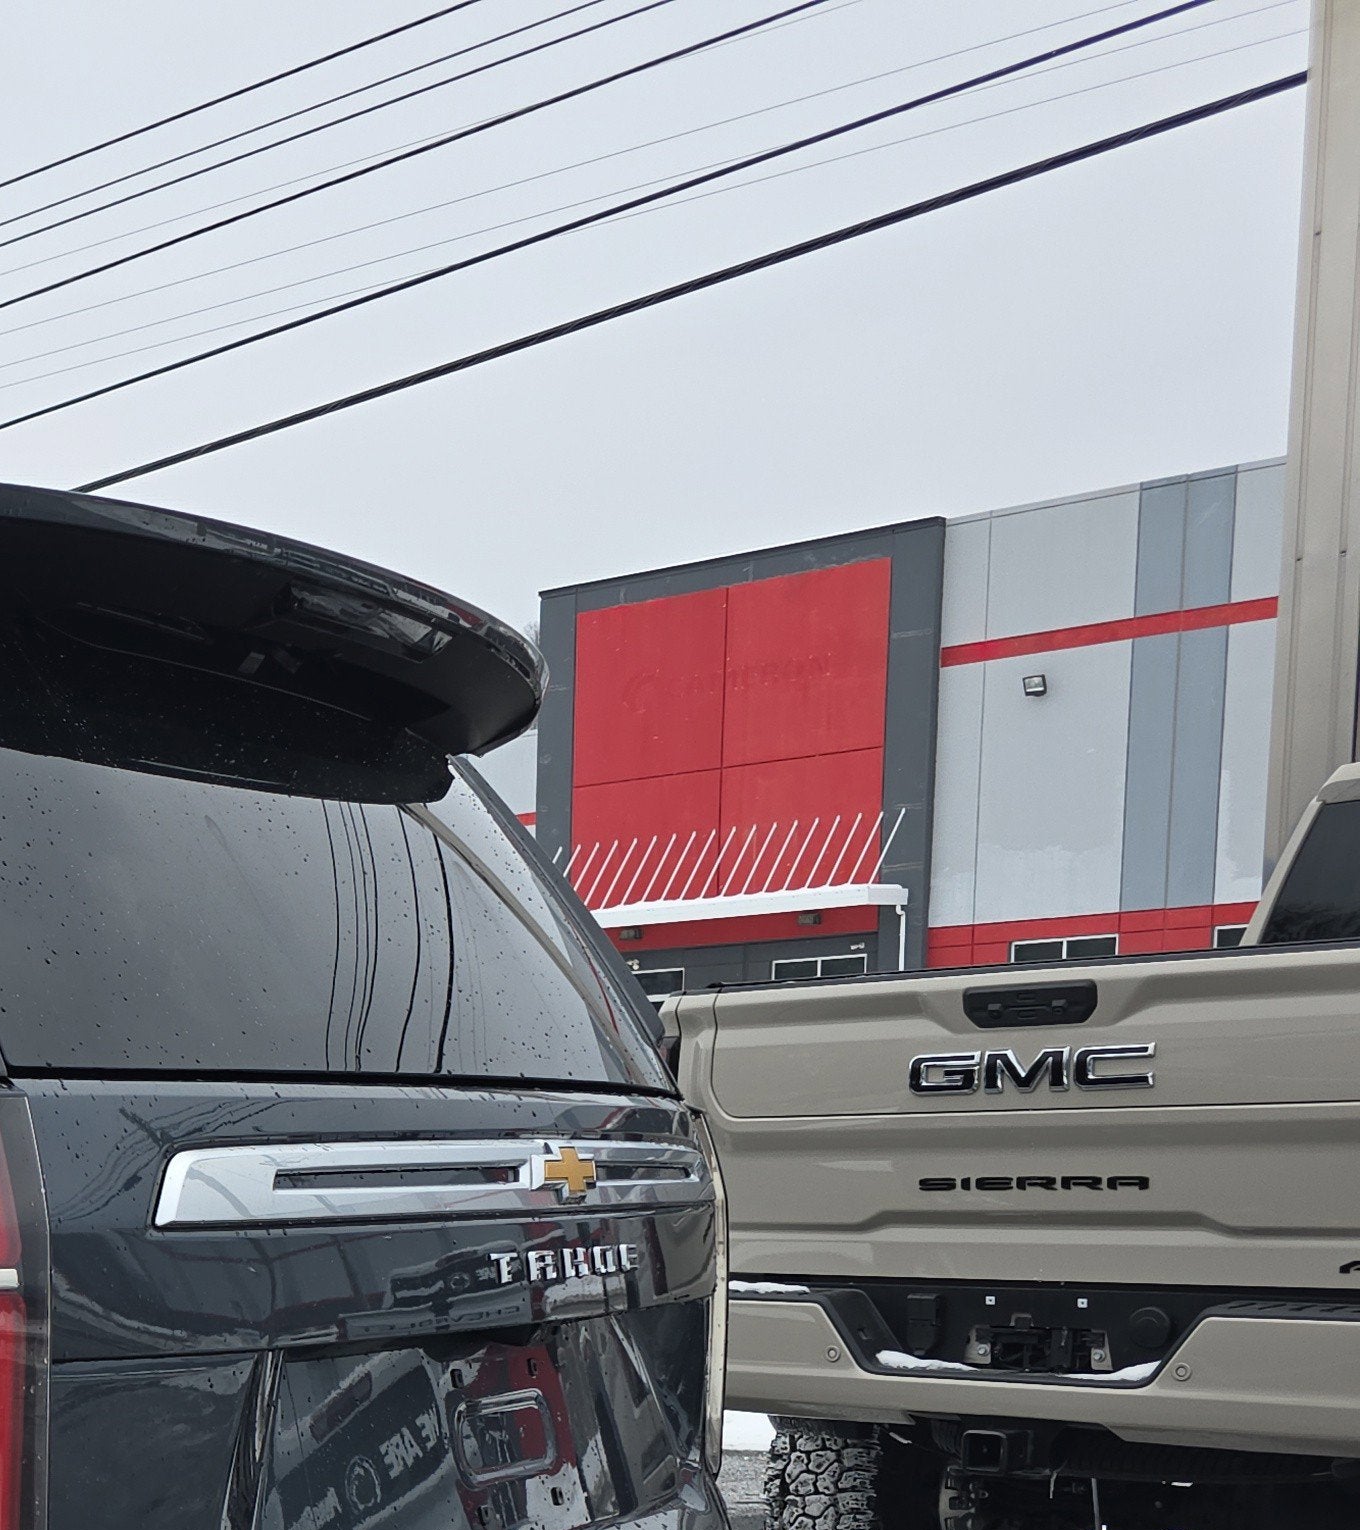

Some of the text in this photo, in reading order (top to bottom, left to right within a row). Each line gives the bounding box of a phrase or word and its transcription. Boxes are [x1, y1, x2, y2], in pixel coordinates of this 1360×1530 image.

[909, 1042, 1156, 1096] GMC
[918, 1175, 1150, 1191] SIERRA
[489, 1244, 638, 1284] TAHOE
